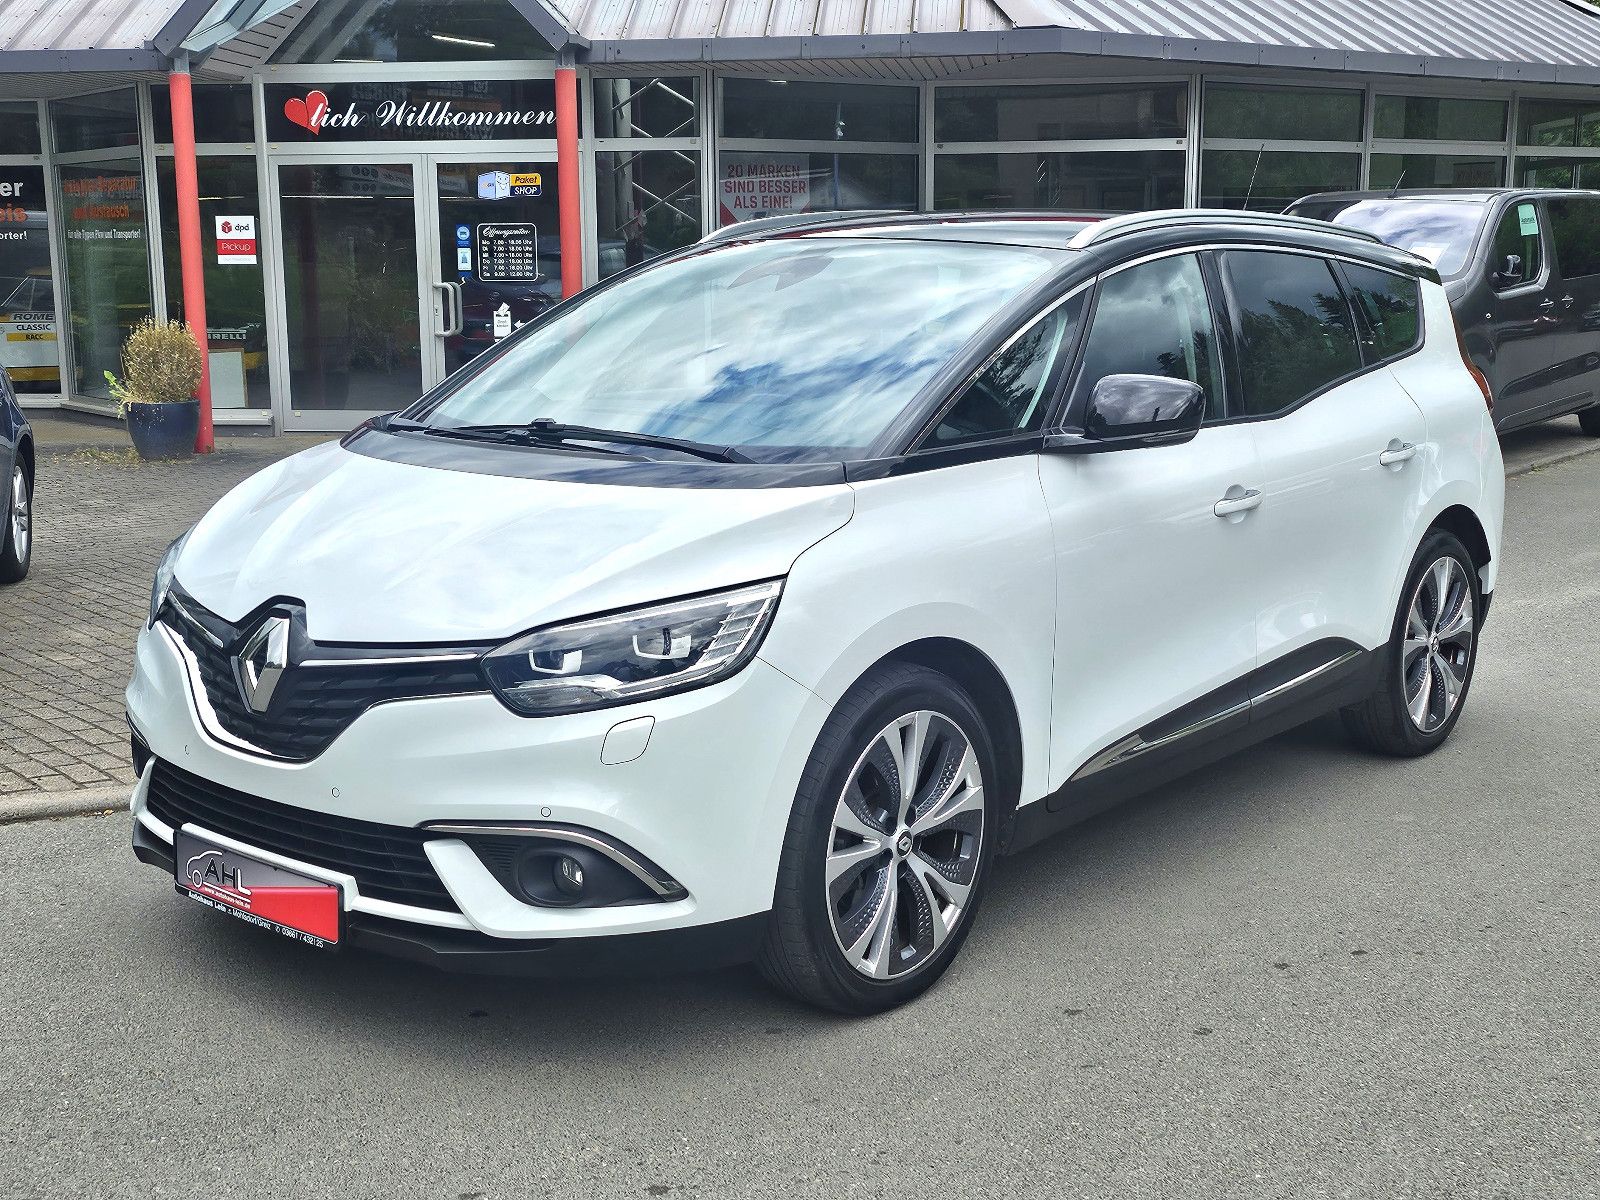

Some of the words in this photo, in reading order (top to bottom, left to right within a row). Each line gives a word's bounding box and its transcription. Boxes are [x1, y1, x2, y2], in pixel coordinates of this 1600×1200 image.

[311, 102, 366, 128] lich
[376, 99, 557, 128] Willkommen
[727, 164, 743, 178] 20
[747, 164, 800, 178] MARKEN
[514, 176, 538, 184] Paket
[724, 180, 755, 194] SIND
[758, 180, 807, 194] BESSER
[514, 186, 538, 195] SHOP
[733, 195, 758, 209] ALS
[761, 195, 793, 209] EINE!
[234, 223, 250, 233] dpd
[221, 242, 251, 252] Pickup
[204, 857, 252, 895] AHL
[188, 890, 214, 907] Autohaus
[302, 934, 324, 949] 432125
